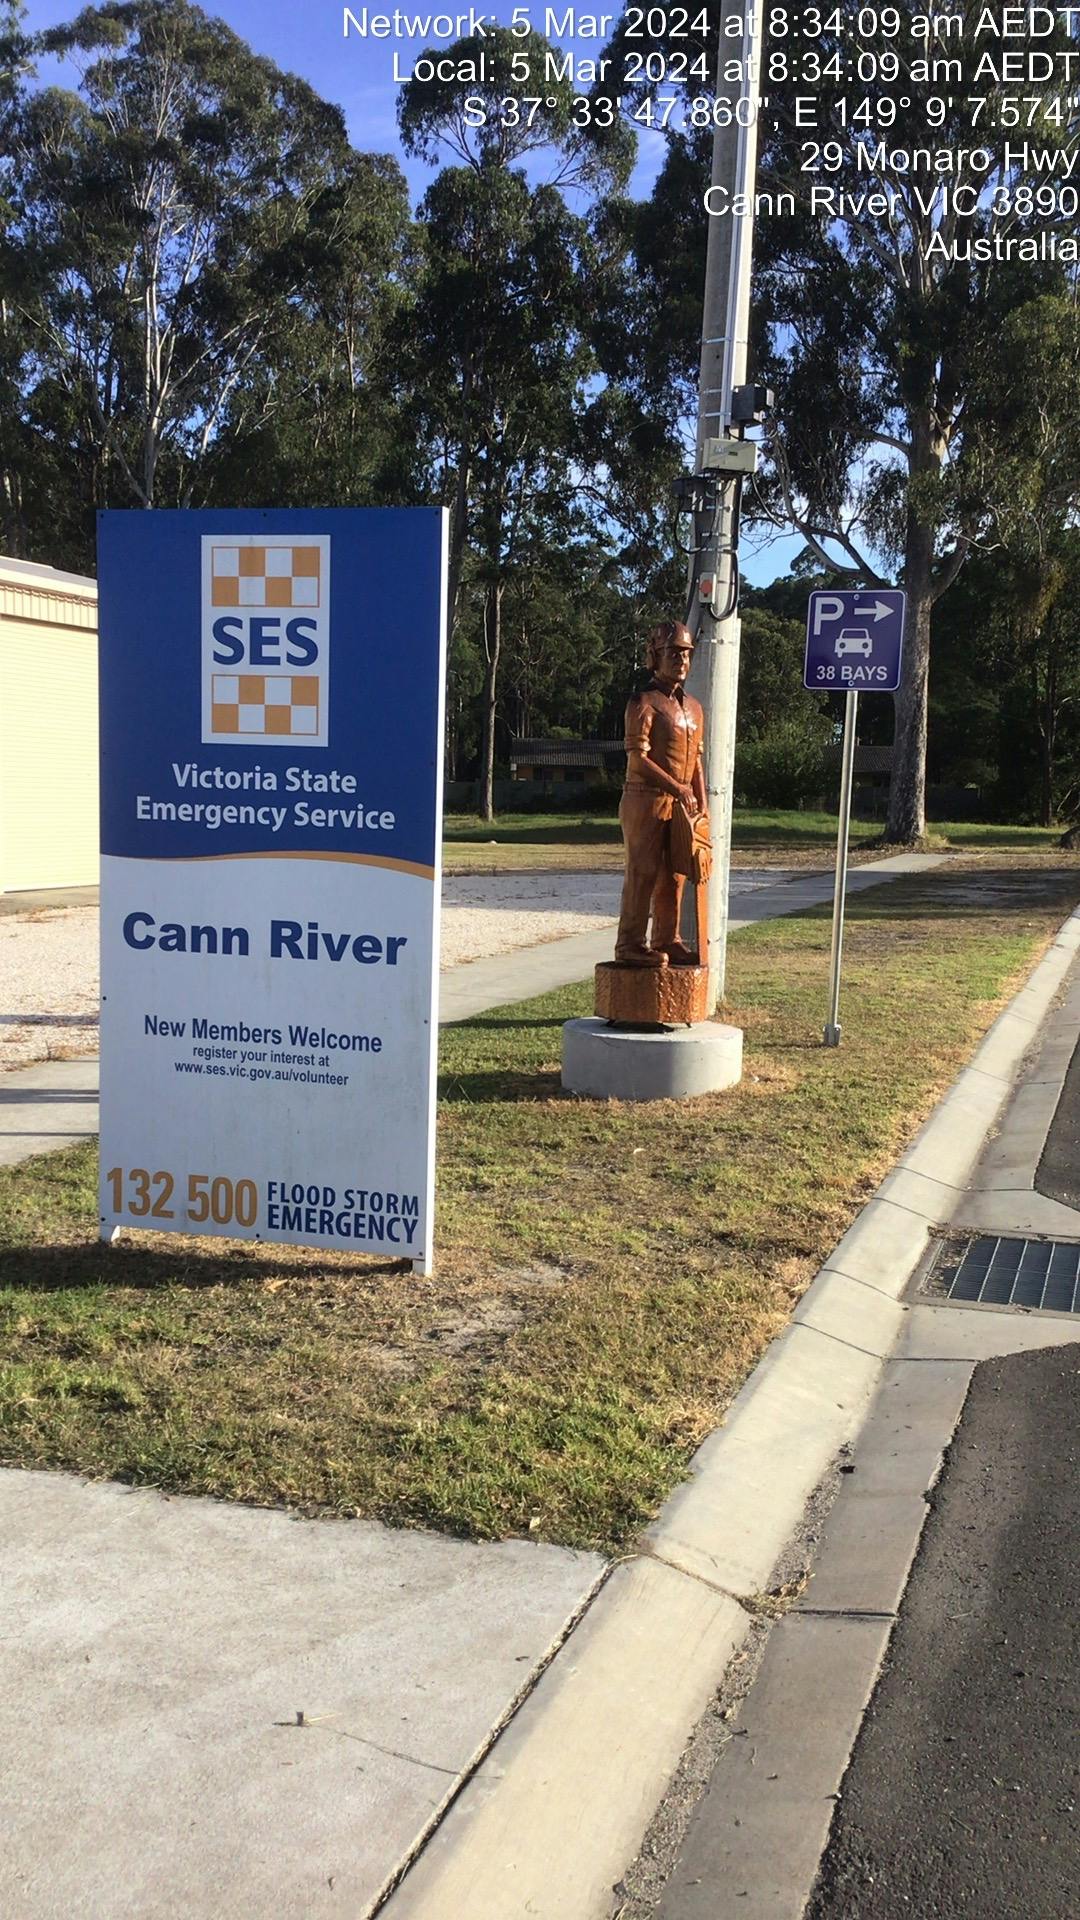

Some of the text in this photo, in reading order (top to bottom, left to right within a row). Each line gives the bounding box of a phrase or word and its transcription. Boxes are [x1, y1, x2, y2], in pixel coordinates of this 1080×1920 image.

[813, 597, 845, 635] P
[212, 616, 319, 666] SES
[816, 666, 888, 681] 38 BAYS
[172, 763, 357, 793] Victoria State
[136, 796, 395, 832] Emergency Service
[122, 911, 408, 965] Cann River
[144, 1014, 383, 1053] New Members Welcome
[174, 1062, 349, 1086] www.ses.vic.gov.au/volunteer
[192, 1045, 330, 1067] register your interest at
[107, 1167, 258, 1227] 132 500
[267, 1181, 419, 1217] FLOOD STORM
[267, 1204, 418, 1244] EMERGENCY
